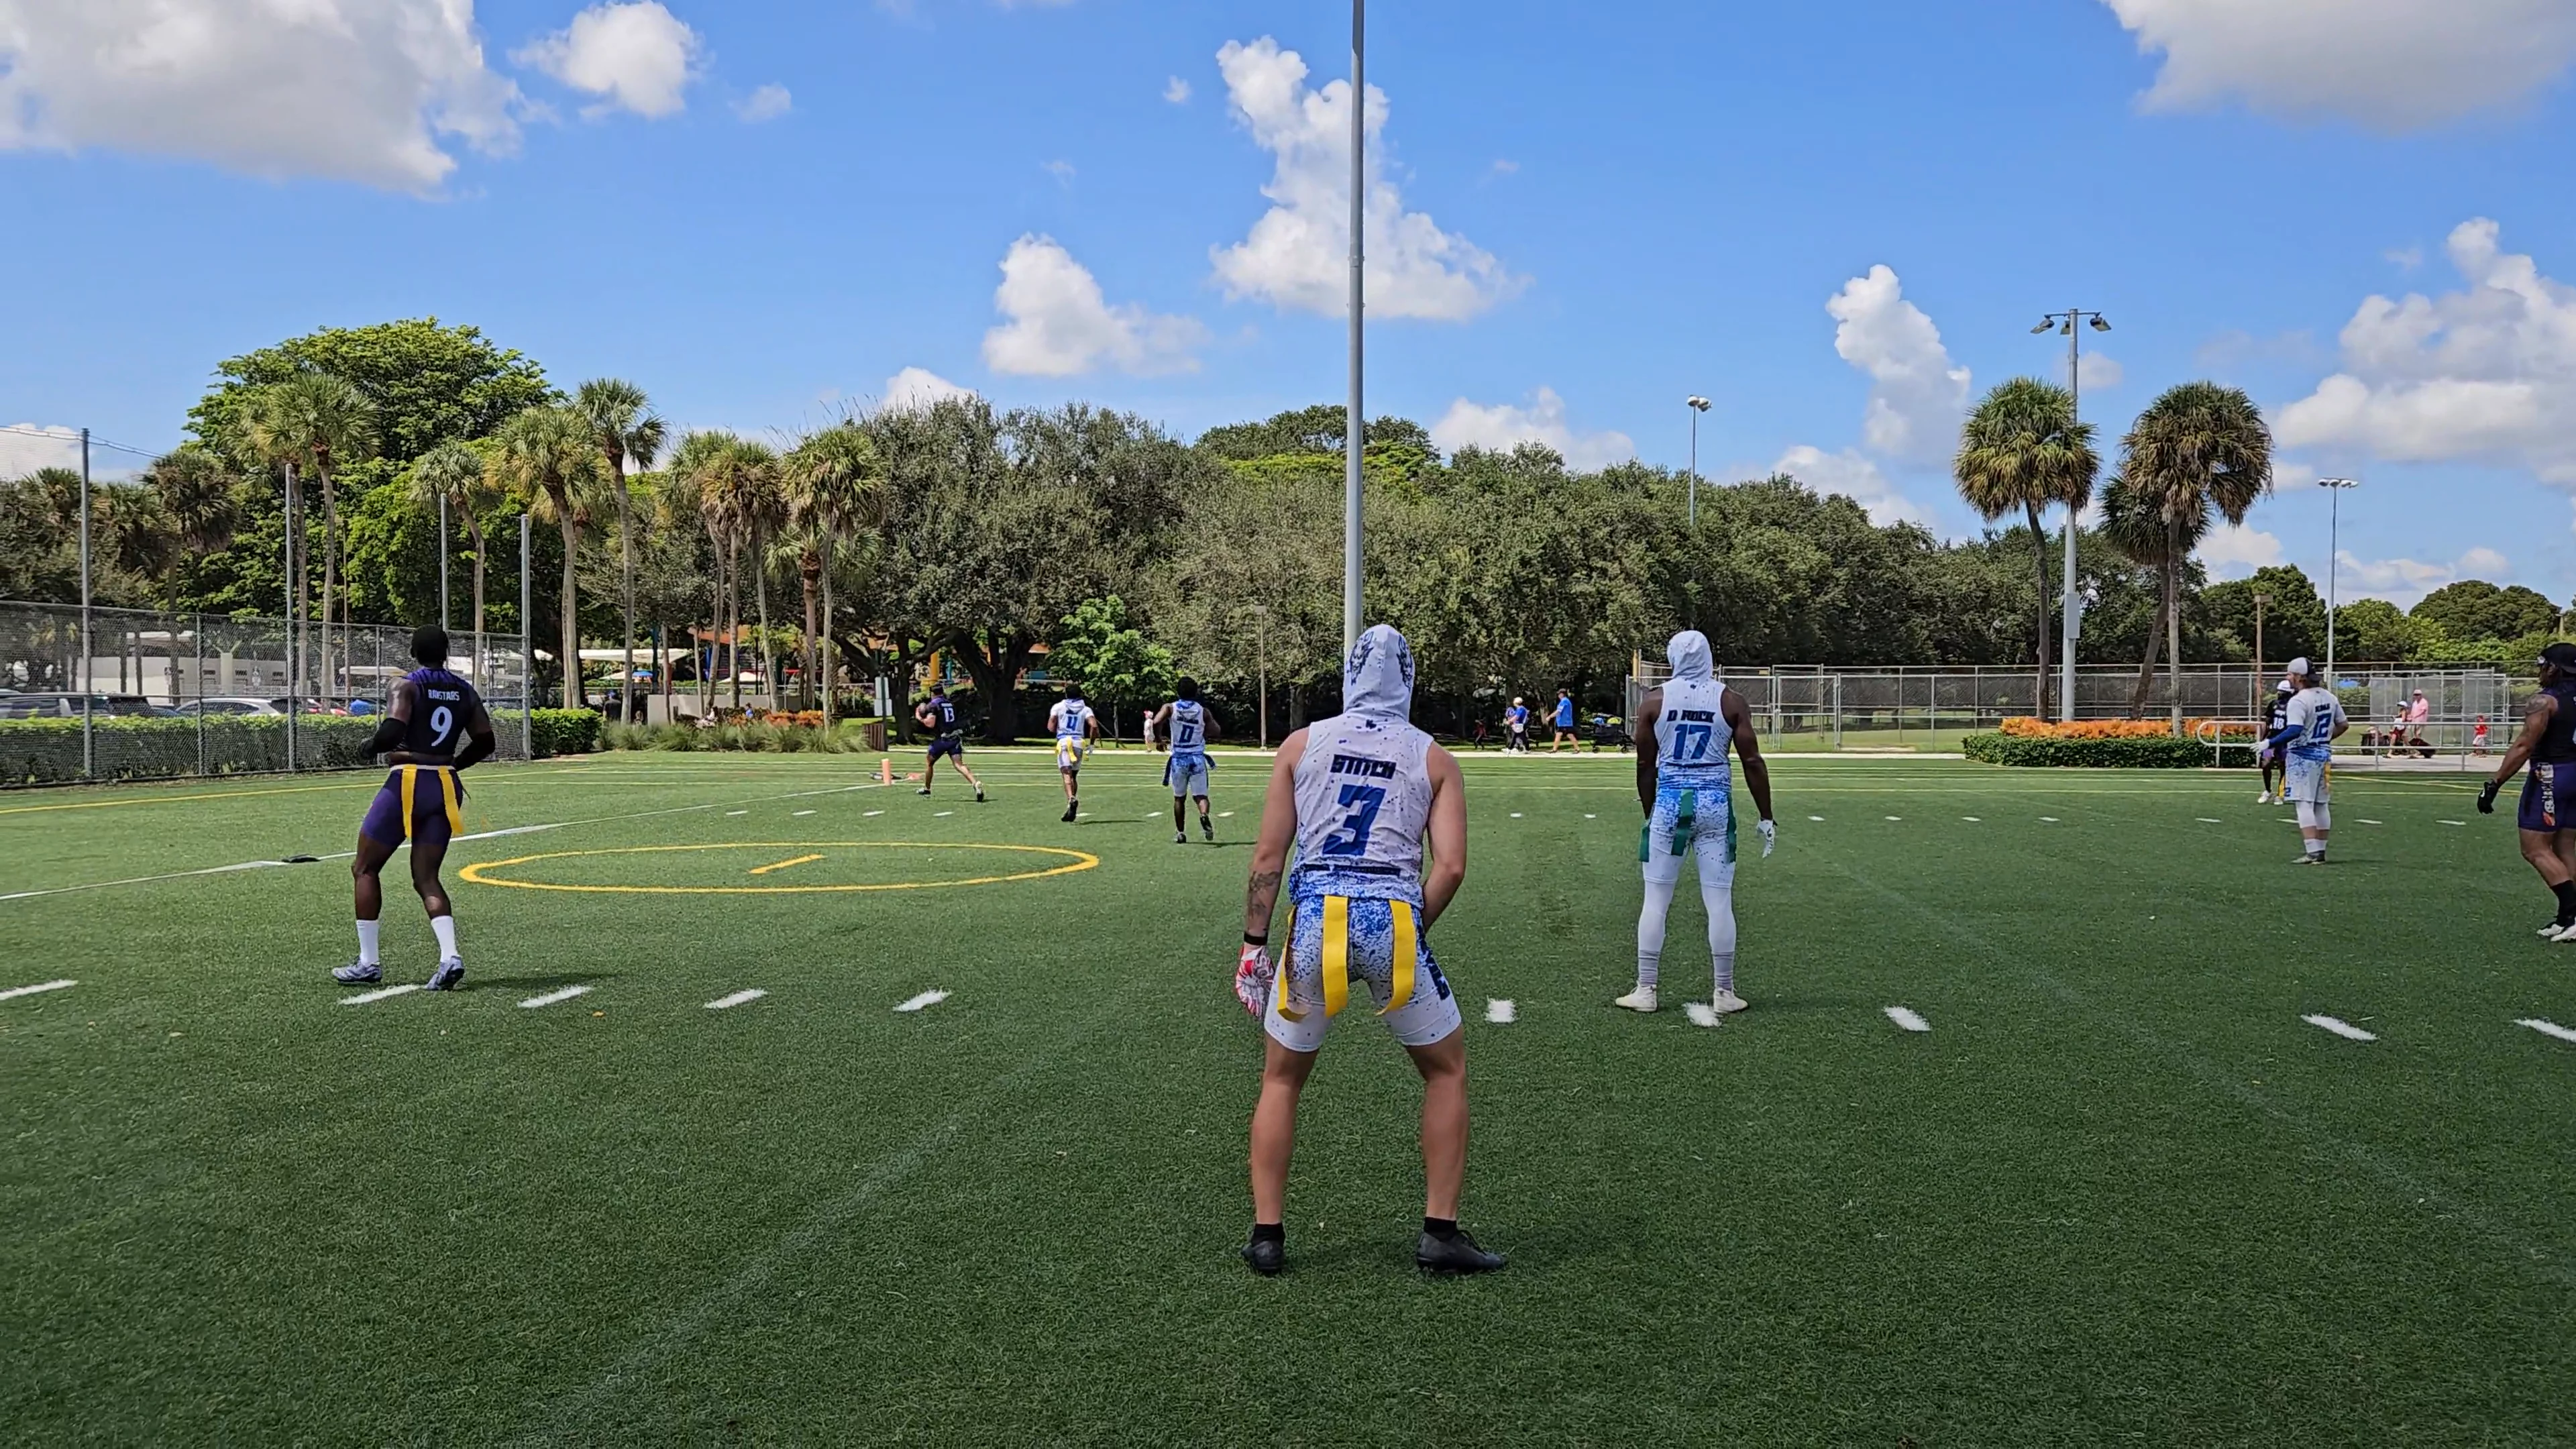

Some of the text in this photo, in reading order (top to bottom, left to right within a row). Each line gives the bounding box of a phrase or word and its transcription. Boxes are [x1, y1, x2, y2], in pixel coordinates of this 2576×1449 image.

[430, 706, 453, 747] 9
[944, 708, 955, 722] 13
[2273, 716, 2285, 730] 18
[2311, 713, 2331, 739] 12
[1672, 723, 1713, 760] 17
[1330, 754, 1397, 780] STITCH
[1322, 784, 1387, 857] 3
